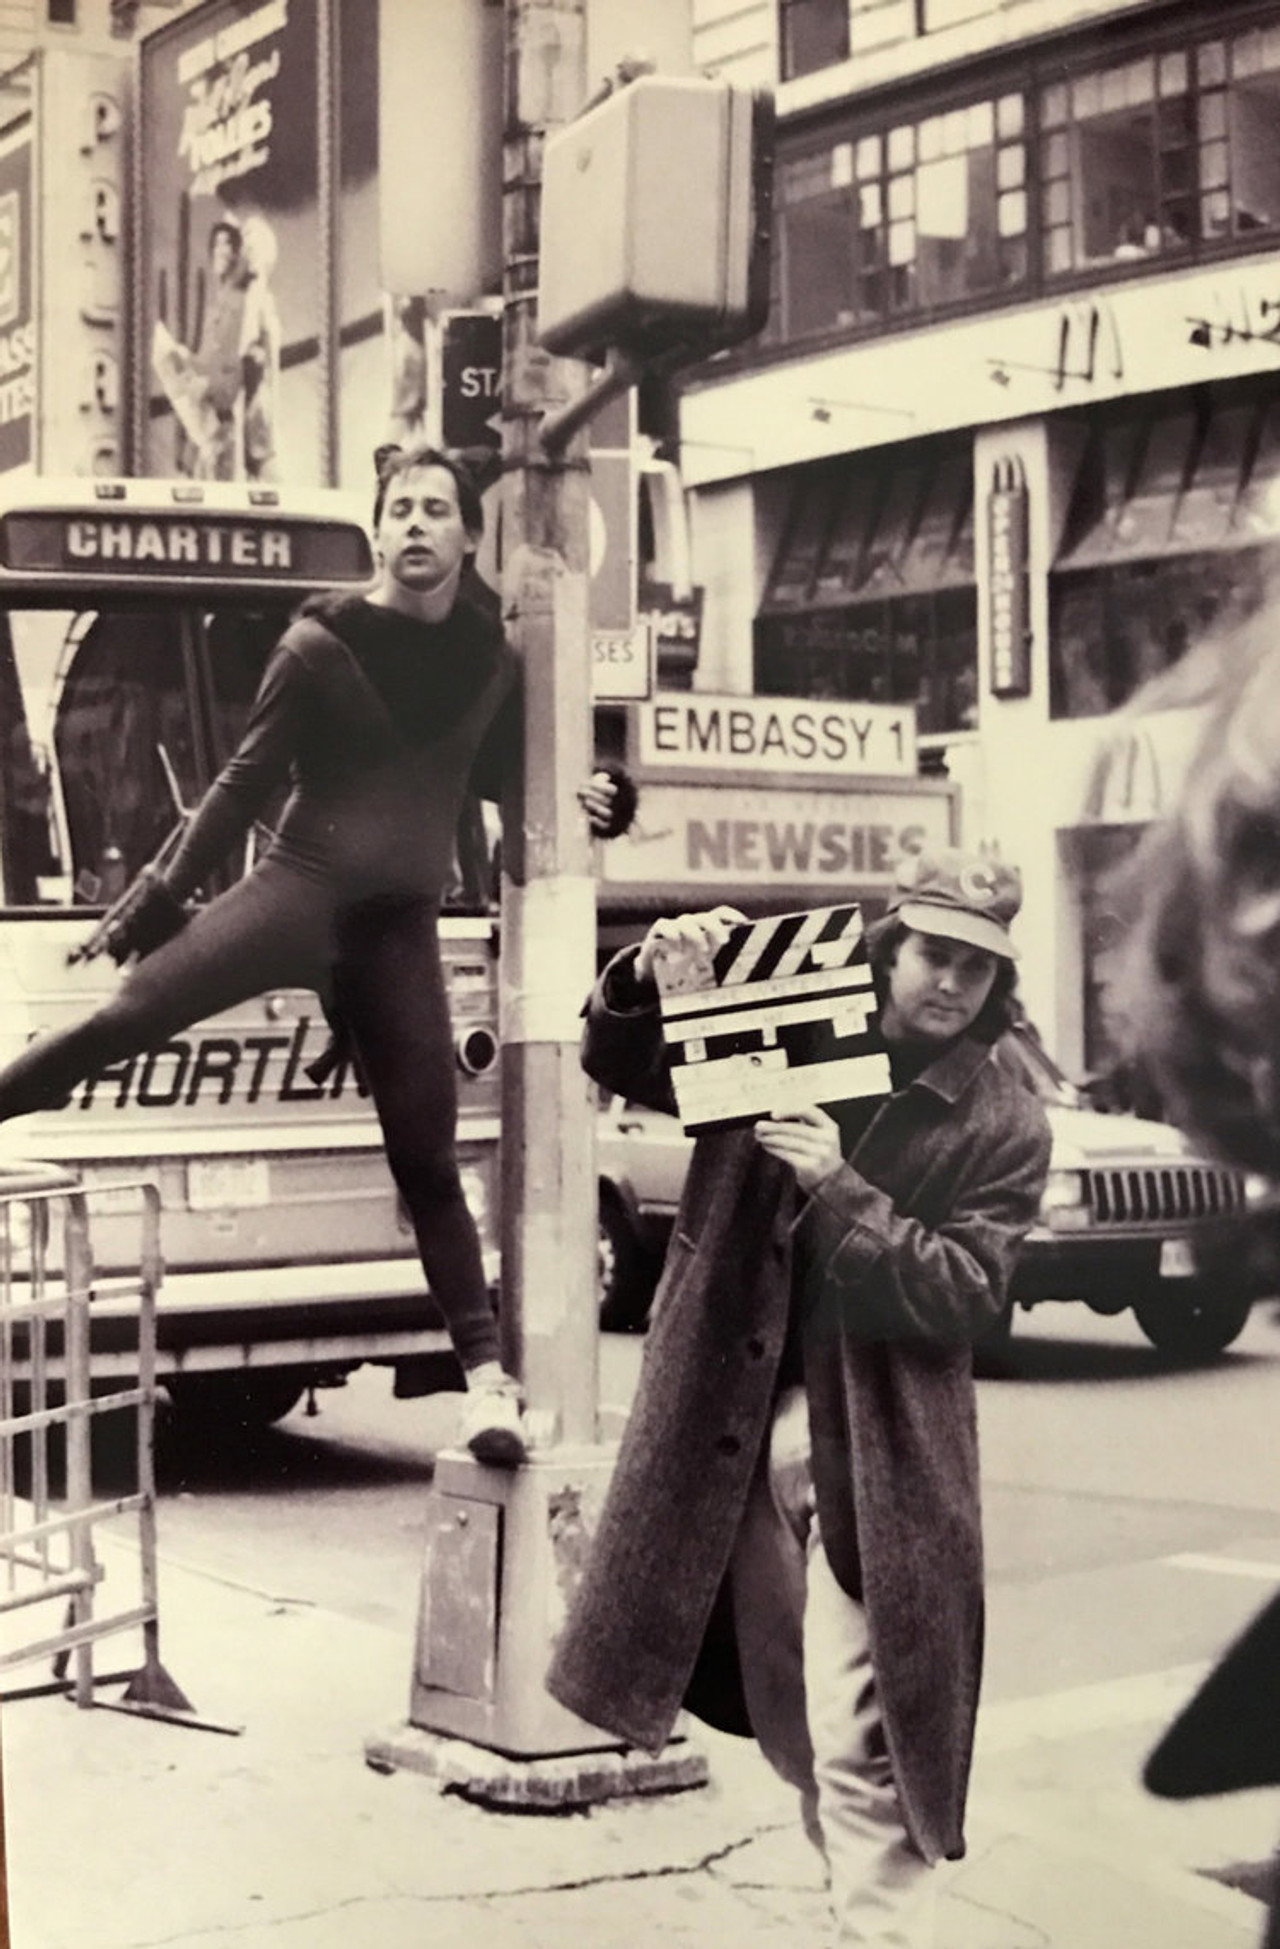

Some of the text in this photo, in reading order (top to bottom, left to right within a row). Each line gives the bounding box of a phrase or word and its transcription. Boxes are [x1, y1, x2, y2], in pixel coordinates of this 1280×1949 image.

[460, 366, 503, 398] ST
[67, 521, 292, 568] CHARTER
[654, 706, 904, 763] EMBASSY 1
[686, 819, 928, 875] NEWSIES
